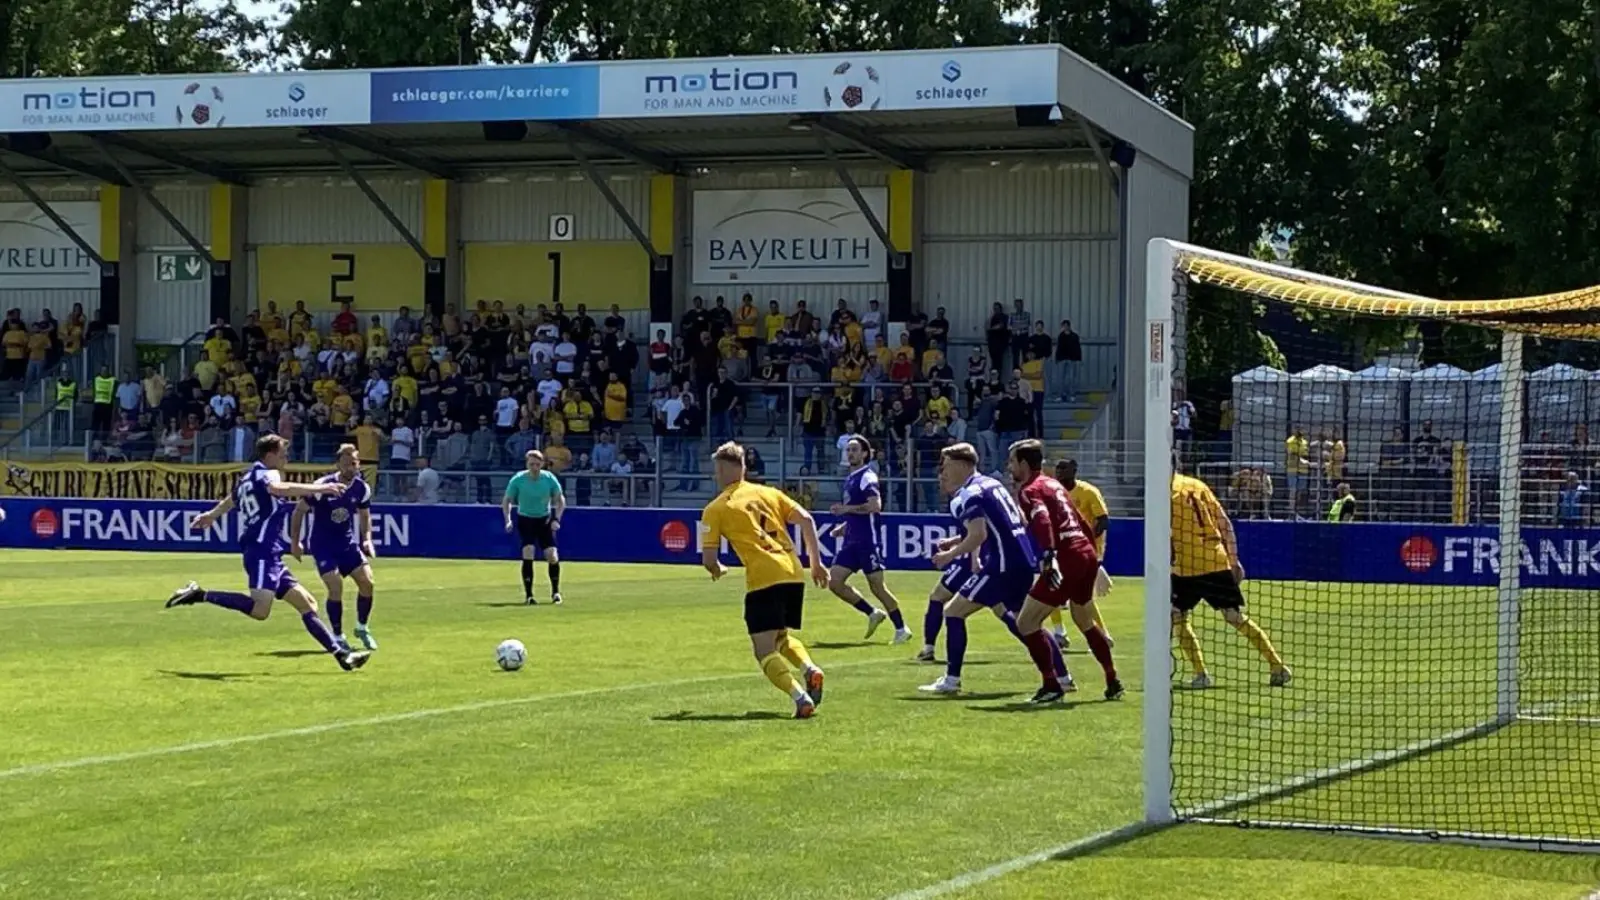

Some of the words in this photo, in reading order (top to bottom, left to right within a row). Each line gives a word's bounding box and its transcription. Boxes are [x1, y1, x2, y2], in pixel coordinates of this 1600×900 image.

[645, 67, 798, 93] motion
[23, 86, 156, 110] motion
[392, 84, 570, 104] schlaeger.com/karriere
[644, 98, 669, 110] FOR
[674, 97, 702, 109] MAN
[708, 96, 734, 108] AND
[740, 94, 797, 107] MACHINE
[916, 86, 988, 101] schlaeger
[22, 115, 43, 125] FOR
[47, 114, 73, 124] MAN
[77, 113, 100, 123] AND
[105, 112, 156, 122] MACHINE
[265, 106, 328, 119] schlaeger
[554, 216, 569, 237] 0
[331, 254, 355, 302] 2
[548, 252, 561, 302] 1
